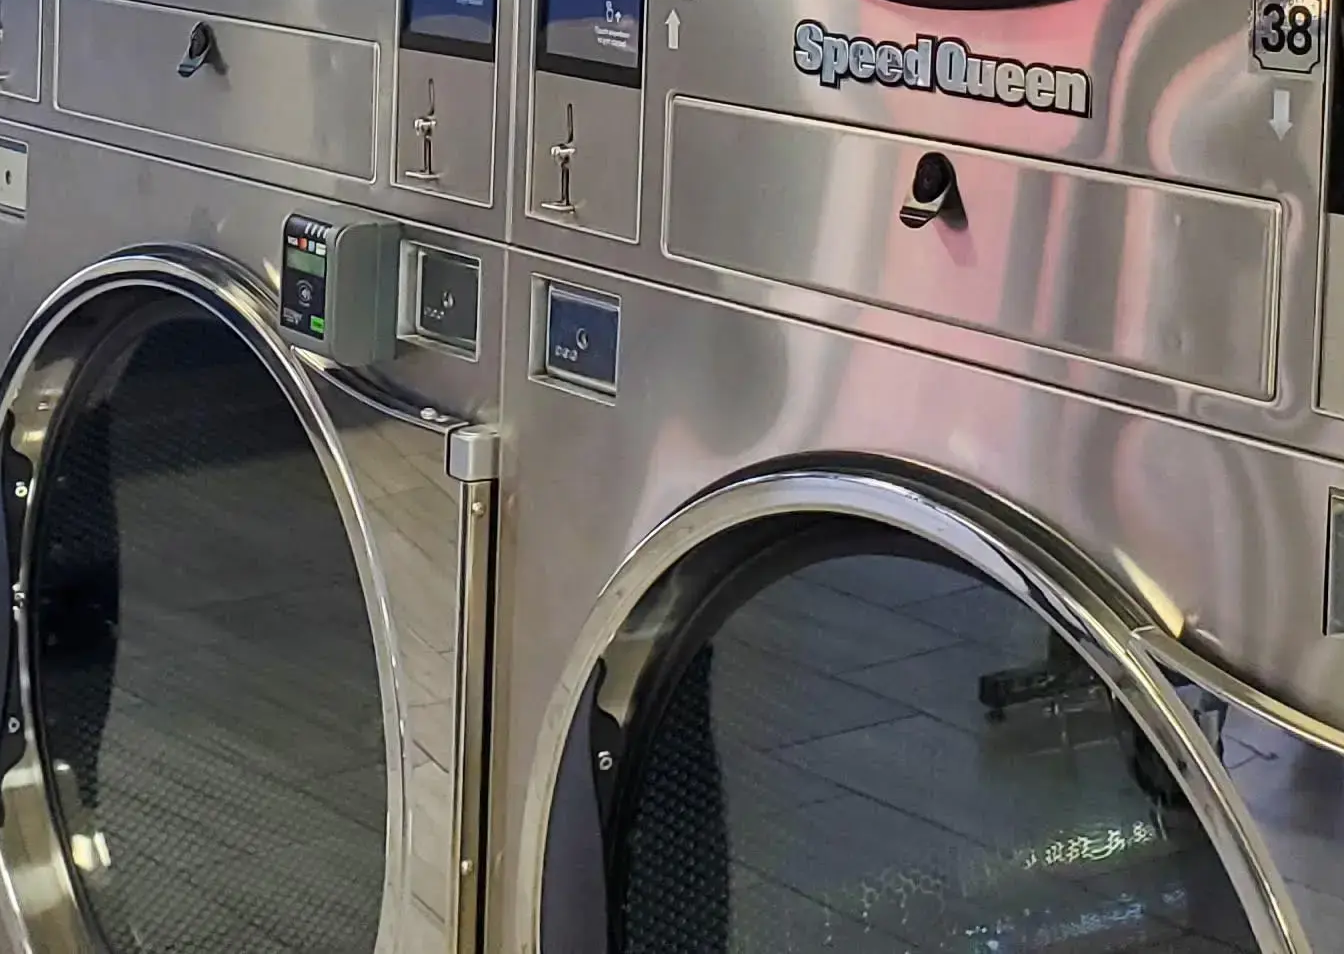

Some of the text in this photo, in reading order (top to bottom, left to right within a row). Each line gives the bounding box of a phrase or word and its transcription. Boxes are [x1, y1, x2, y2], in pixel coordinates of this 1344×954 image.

[1260, 3, 1312, 55] 38
[794, 19, 1092, 118] Speed Queen
